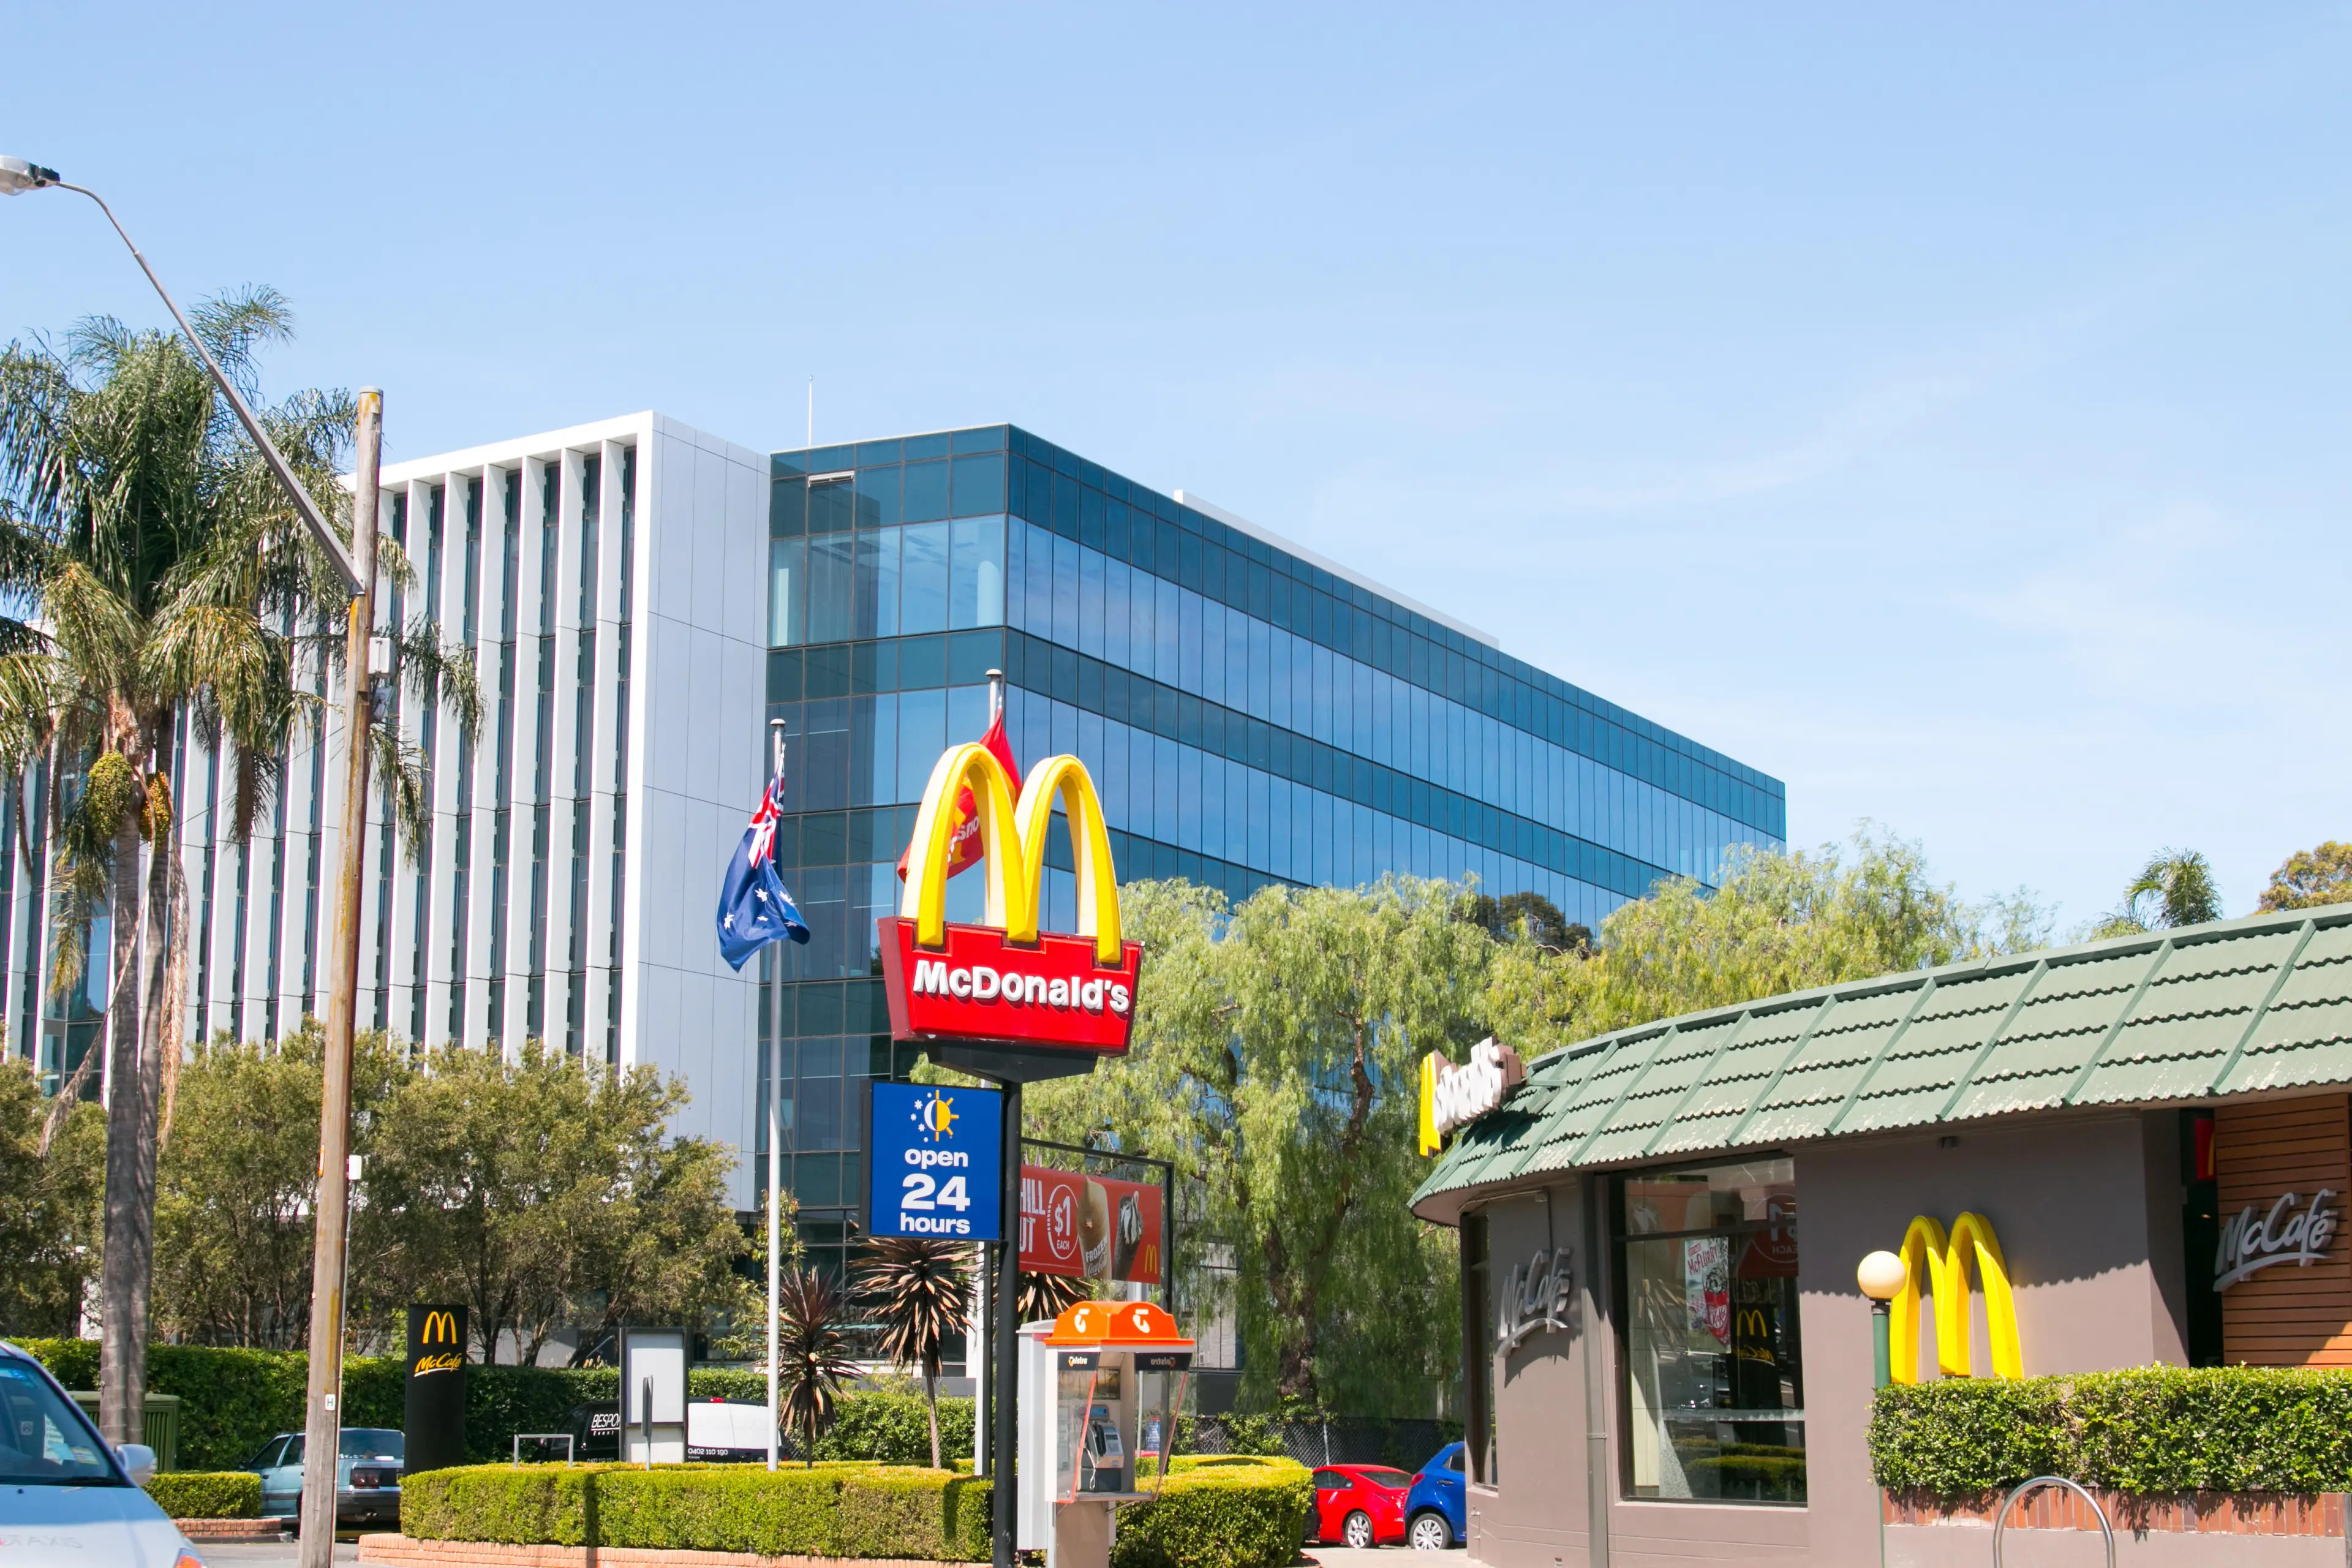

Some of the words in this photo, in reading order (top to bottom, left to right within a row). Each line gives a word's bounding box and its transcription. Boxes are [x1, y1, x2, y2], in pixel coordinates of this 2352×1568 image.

[913, 960, 1129, 1012] McDonald's
[905, 1148, 968, 1170] open
[901, 1173, 971, 1212] 24
[900, 1212, 971, 1234] hours
[1054, 1196, 1071, 1237] $1
[1057, 1239, 1070, 1250] EACH
[1085, 1232, 1107, 1262] FROZEN
[2214, 1188, 2337, 1287] McCafé
[415, 1352, 463, 1376] McCafé
[326, 1397, 334, 1408] H
